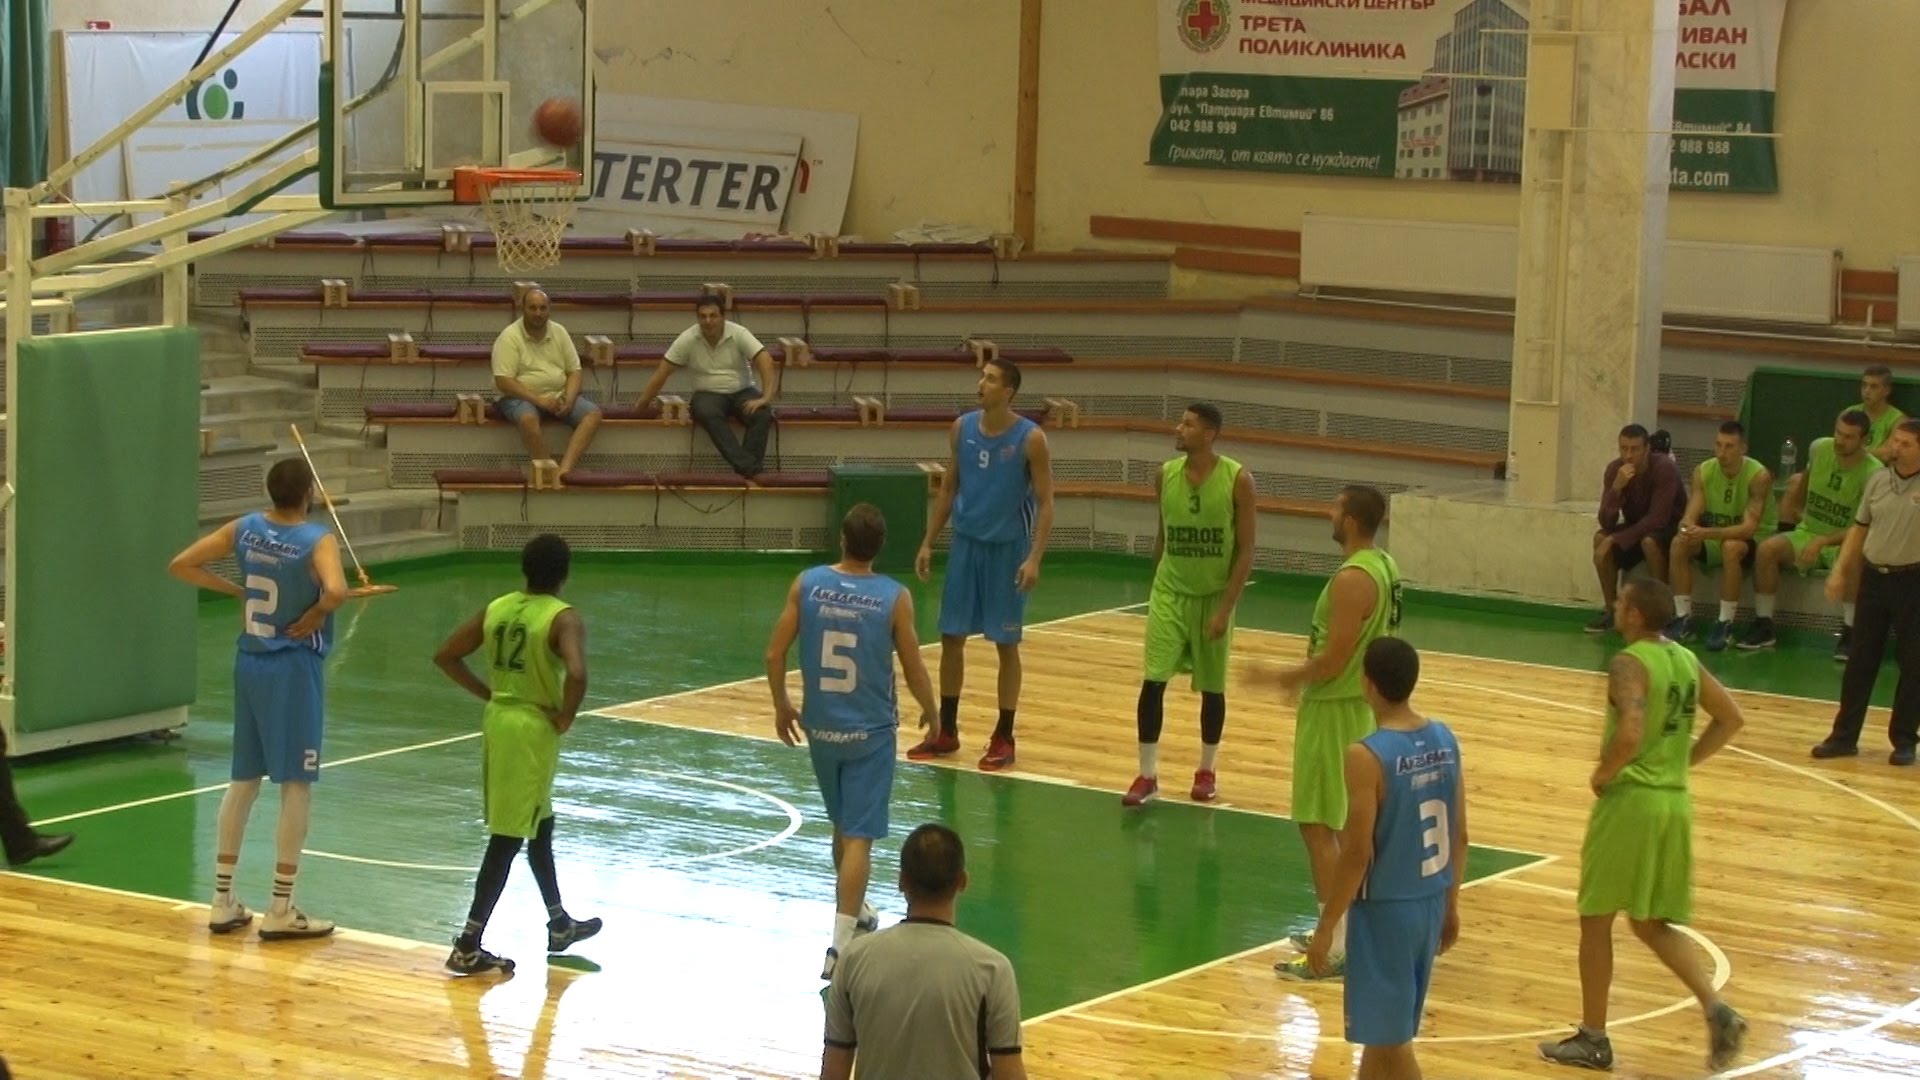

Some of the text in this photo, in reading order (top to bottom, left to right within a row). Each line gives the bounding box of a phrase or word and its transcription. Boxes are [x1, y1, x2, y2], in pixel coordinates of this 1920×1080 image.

[1240, 15, 1306, 33] ТРЕТА
[1682, 27, 1747, 44] ИВАН
[1239, 38, 1406, 60] ПОЛИКЛИНИКА
[1212, 85, 1250, 101] Загора
[1170, 119, 1191, 132] 042
[1217, 121, 1237, 134] 999
[1232, 148, 1250, 162] от
[1296, 153, 1310, 166] се
[979, 450, 990, 468] 9
[1827, 472, 1843, 491] 13
[1189, 495, 1201, 514] 3
[1167, 526, 1224, 544] BEROE
[246, 574, 278, 638] 2
[493, 621, 527, 673] 12
[820, 630, 858, 693] 5
[304, 749, 318, 770] 2
[1419, 799, 1450, 878] 3
